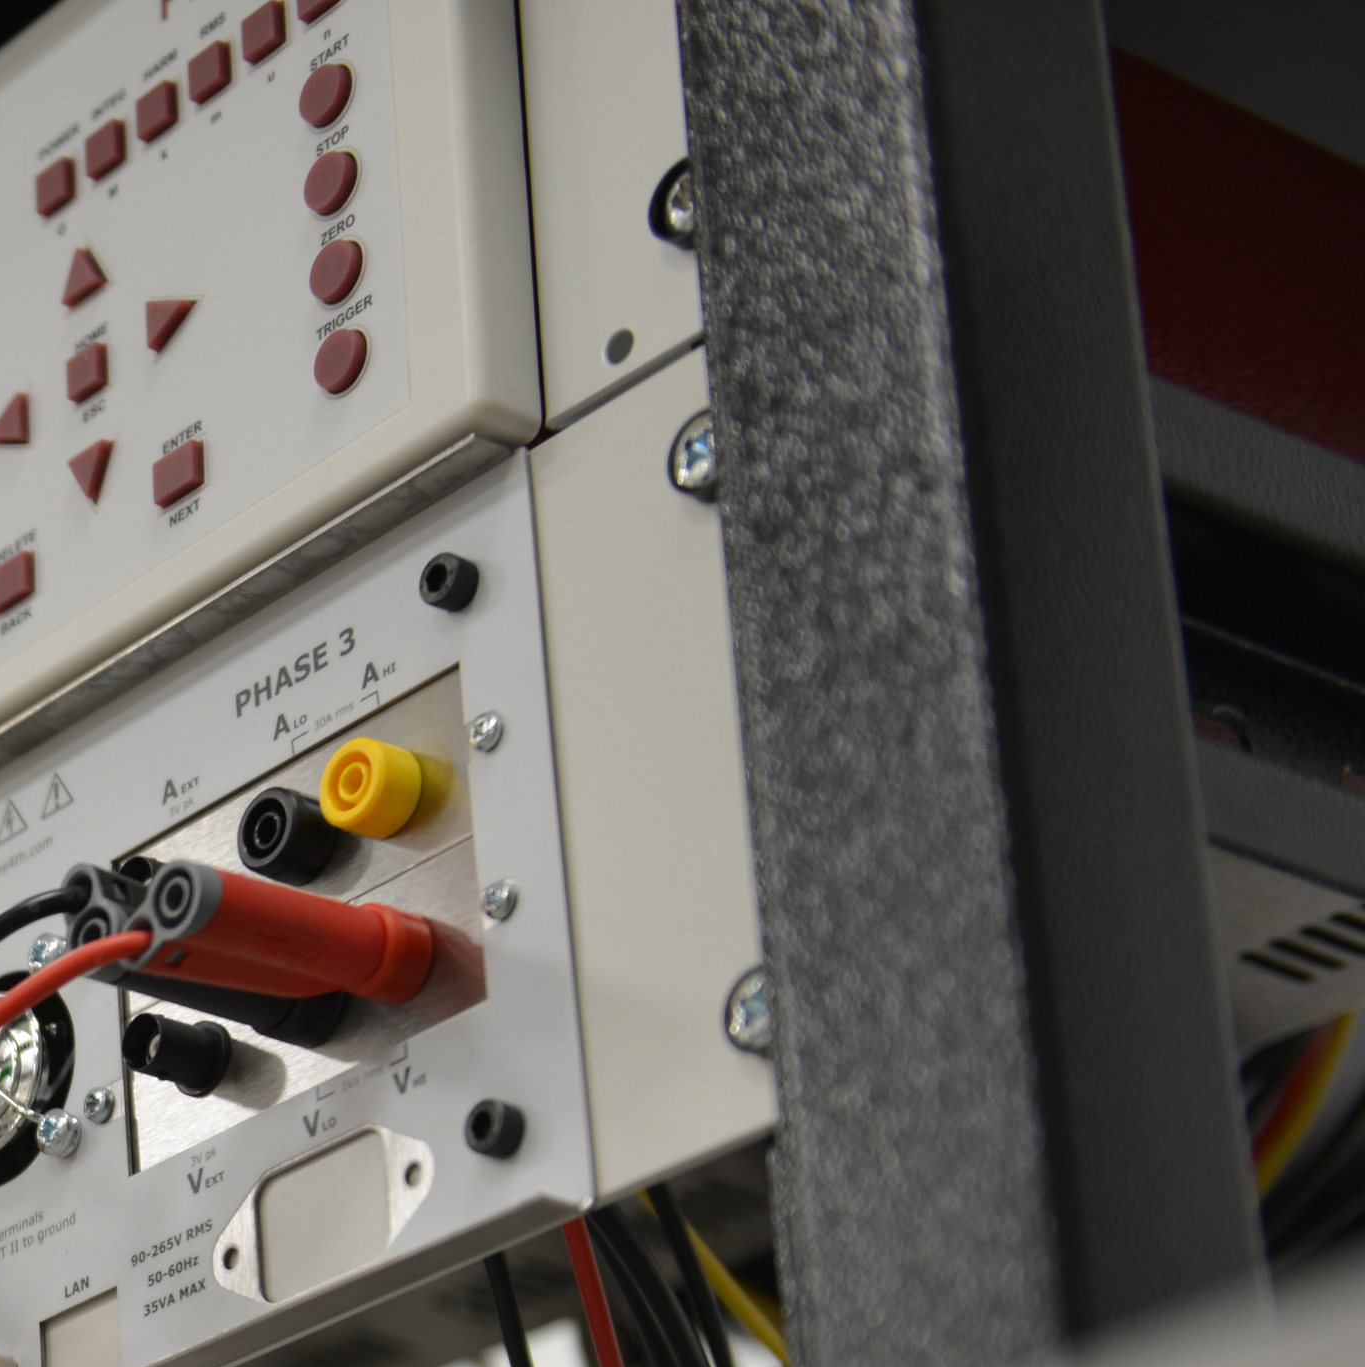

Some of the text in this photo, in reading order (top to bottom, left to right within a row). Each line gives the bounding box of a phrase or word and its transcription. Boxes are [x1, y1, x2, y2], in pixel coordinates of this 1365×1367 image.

[199, 12, 226, 39] RMS
[143, 48, 178, 82] HARM
[310, 33, 350, 72] START
[316, 125, 350, 157] STOP
[320, 214, 356, 247] ZERO
[316, 294, 373, 341] TRIGGER
[74, 322, 108, 355] HOME
[82, 399, 106, 422] ESC
[162, 420, 203, 455] ENTER
[169, 498, 201, 528] NEXT
[0, 608, 32, 635] BACK
[235, 627, 356, 719] PHASE 3
[10, 1241, 19, 1255] II
[23, 1233, 34, 1249] to
[37, 1211, 76, 1244] ground
[130, 1219, 214, 1268] 90-265V RMS
[64, 1276, 91, 1299] LAN
[147, 1255, 200, 1288] 50-60Hz
[143, 1278, 207, 1317] 35VA MAX
